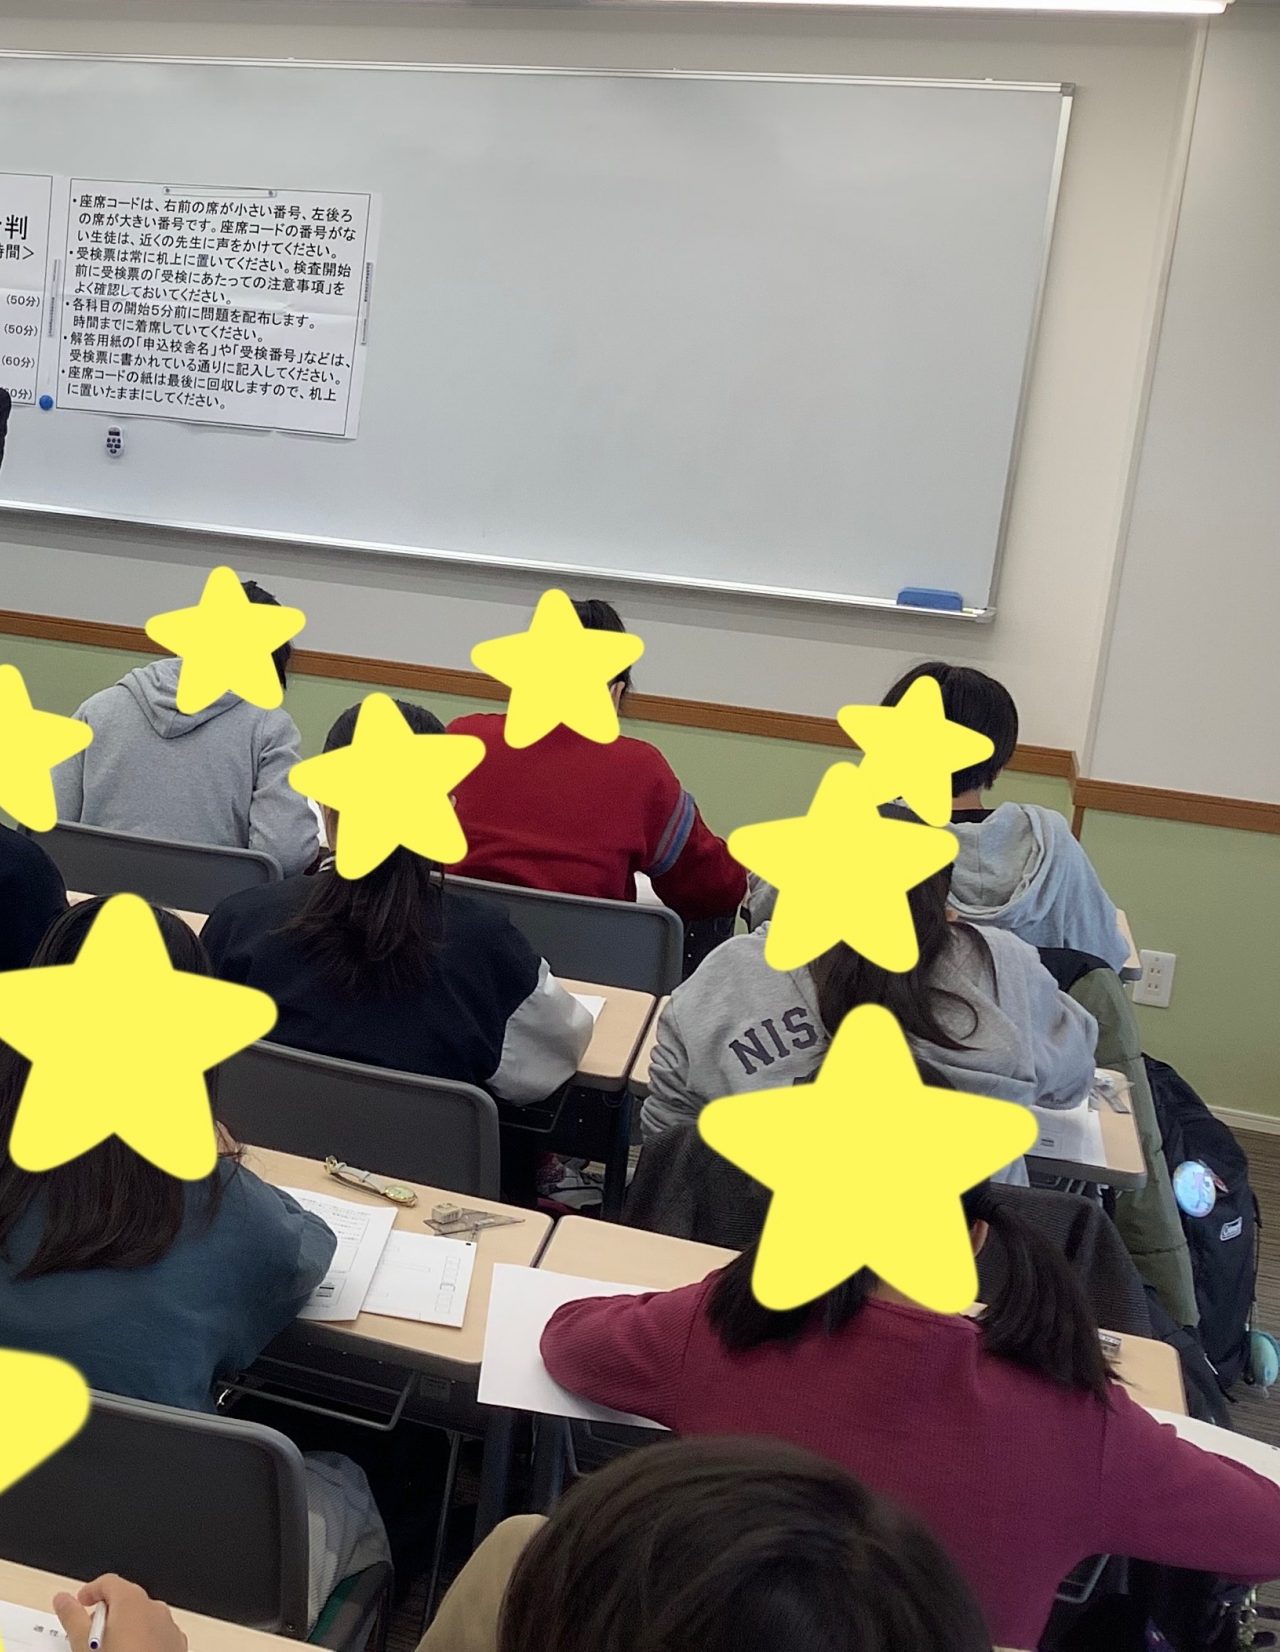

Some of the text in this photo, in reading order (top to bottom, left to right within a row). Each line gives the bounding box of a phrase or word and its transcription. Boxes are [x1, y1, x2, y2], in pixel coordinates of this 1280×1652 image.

[78, 212, 357, 241] の席が大きい番号です。座席コードの番号がな
[77, 230, 337, 259] い生徒は、近くの先生に声をかけてください。
[74, 281, 232, 305] よく確認しておいてください。
[75, 264, 346, 296] 前に受検票の「受検にあたっての注意事項」を
[6, 294, 40, 307] (50分)
[4, 324, 38, 336] (50分)
[73, 315, 263, 343] 時間までに着席していてください。
[1, 355, 35, 369] (60分)
[69, 349, 340, 385] 受検票に書かれている通りに記入してください。
[67, 383, 226, 410] に置いたままにしてください。
